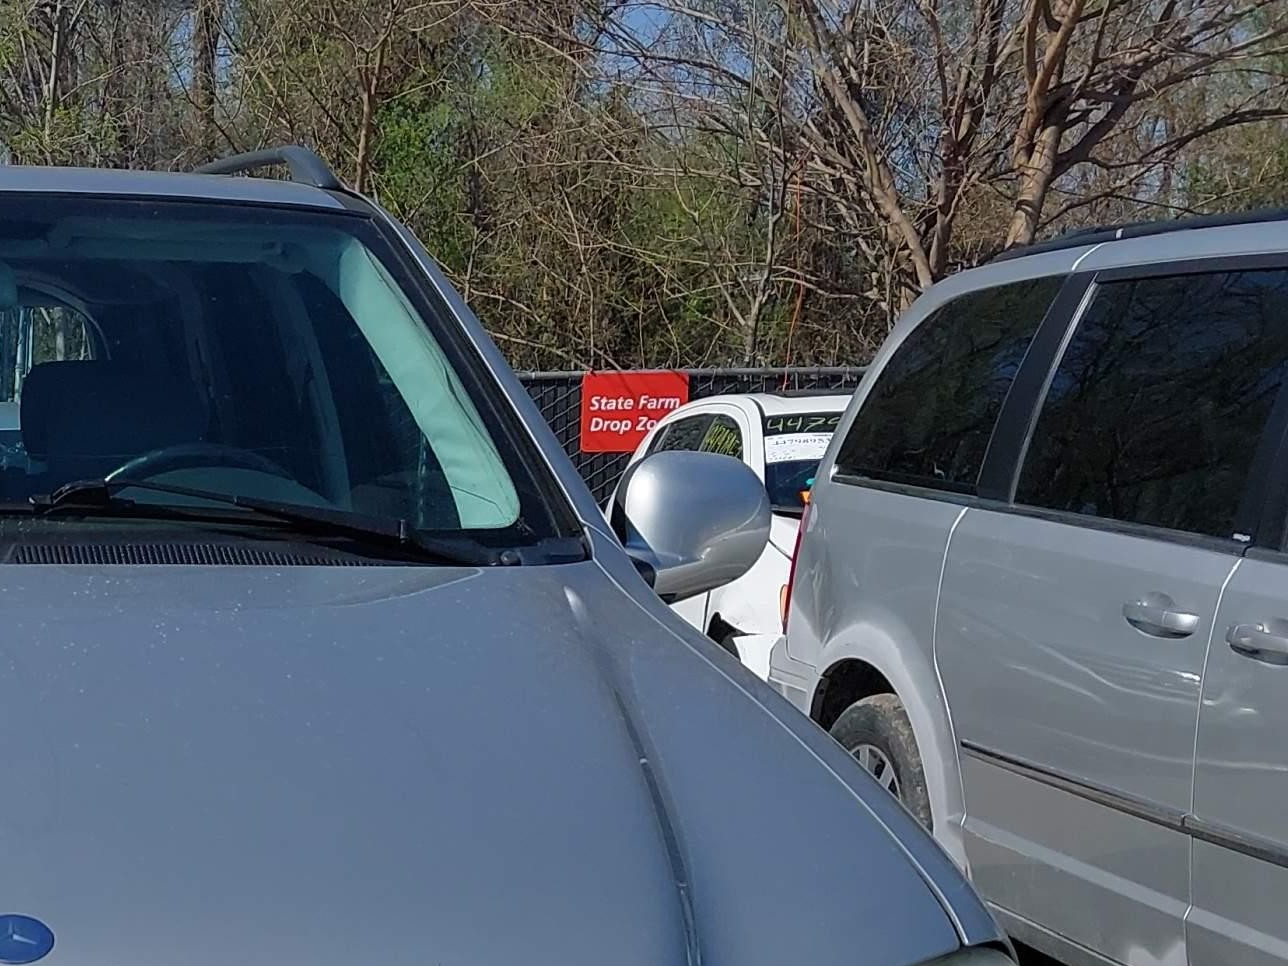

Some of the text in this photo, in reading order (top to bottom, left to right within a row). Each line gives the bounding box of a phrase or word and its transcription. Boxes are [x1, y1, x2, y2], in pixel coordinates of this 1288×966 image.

[589, 395, 680, 411] State Farm
[590, 416, 657, 434] Drop Zo
